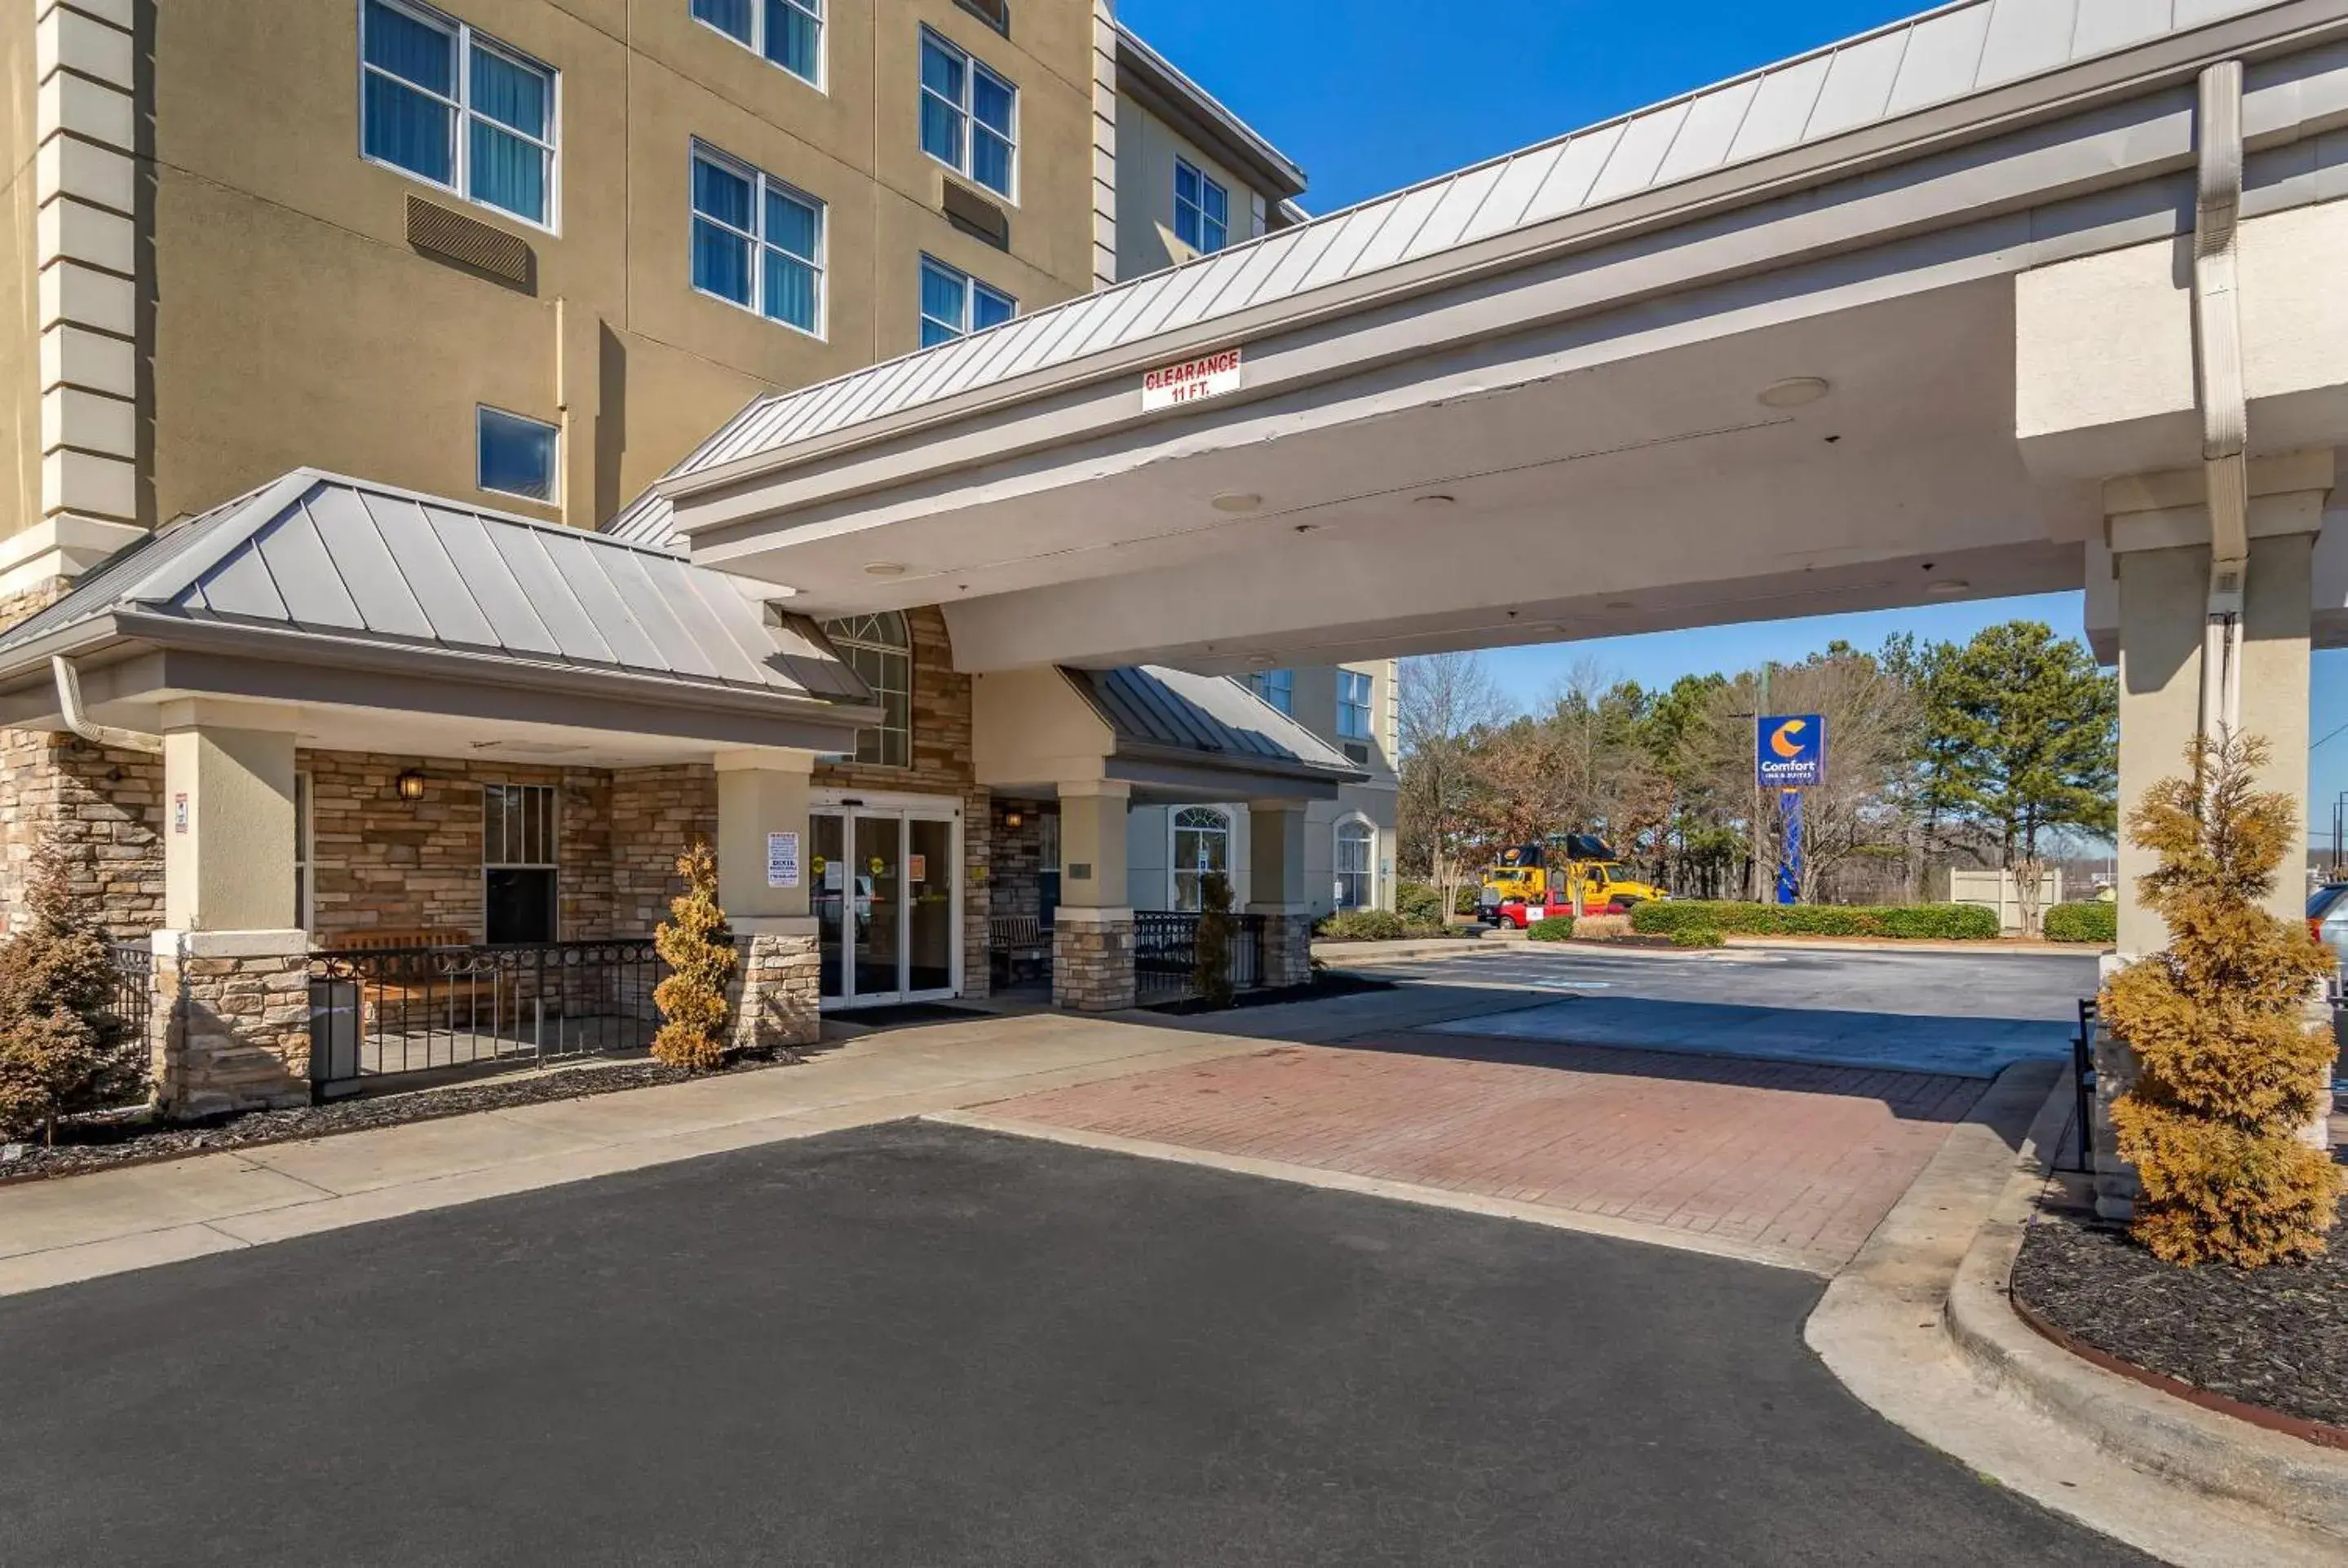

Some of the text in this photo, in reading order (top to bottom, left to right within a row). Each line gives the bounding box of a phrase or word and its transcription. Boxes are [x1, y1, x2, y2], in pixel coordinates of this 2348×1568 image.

[1145, 351, 1238, 390] CLEARANCE
[1172, 386, 1184, 402] 11
[1762, 759, 1815, 772] Comfort
